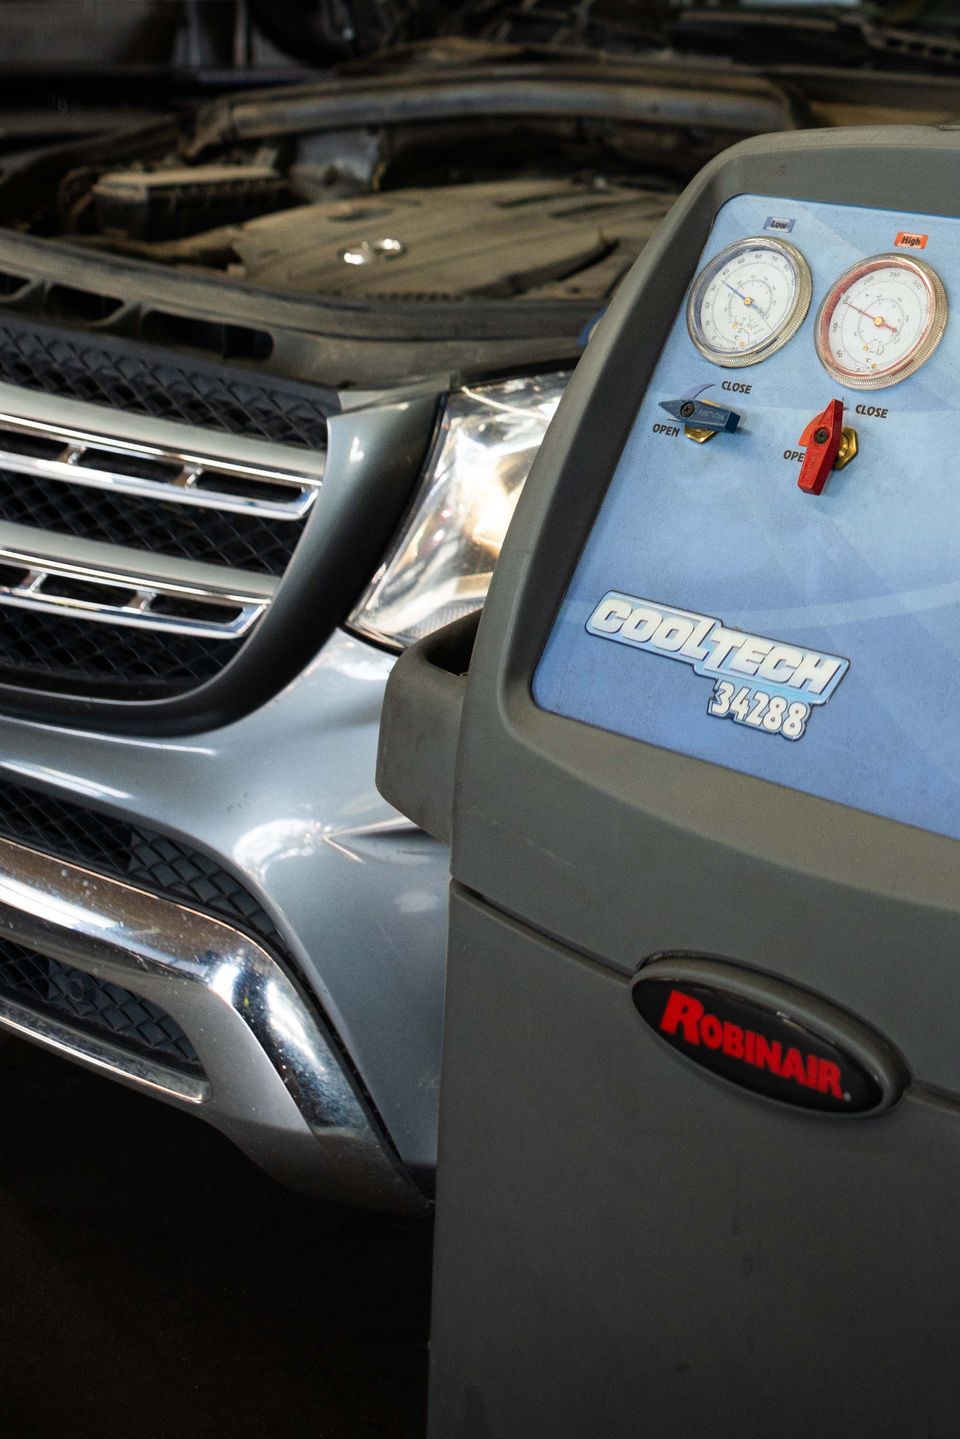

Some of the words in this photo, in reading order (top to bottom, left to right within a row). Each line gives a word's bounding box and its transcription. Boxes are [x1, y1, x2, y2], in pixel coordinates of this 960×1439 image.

[771, 218, 788, 230] Low
[900, 234, 921, 247] High
[721, 380, 752, 395] CLOSE
[855, 403, 889, 419] CLOSE
[652, 422, 681, 438] OPEN
[783, 449, 804, 463] OPE
[710, 680, 808, 737] 34288
[658, 989, 845, 1101] ROBINAIR
